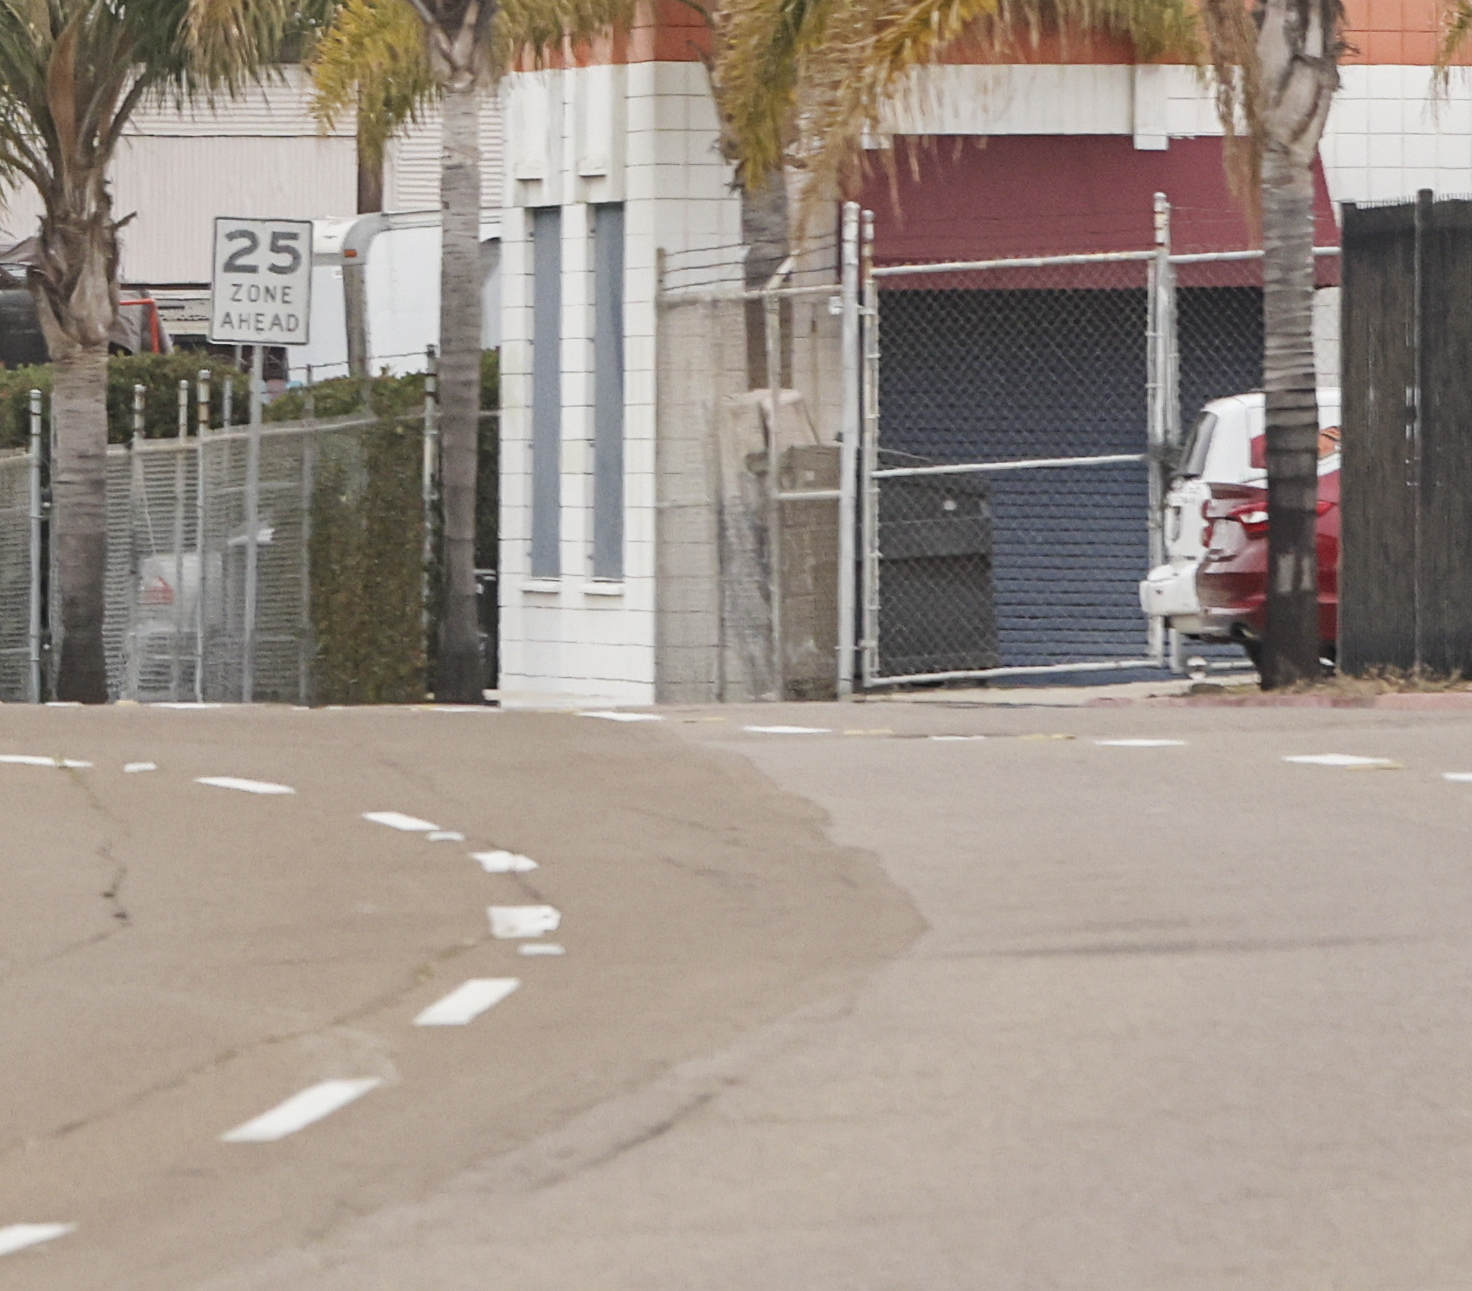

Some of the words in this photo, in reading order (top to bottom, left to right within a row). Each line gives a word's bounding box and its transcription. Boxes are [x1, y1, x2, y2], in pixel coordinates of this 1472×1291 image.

[223, 229, 302, 275] 25
[230, 283, 293, 304] ZONE
[221, 311, 300, 332] AHEAD
